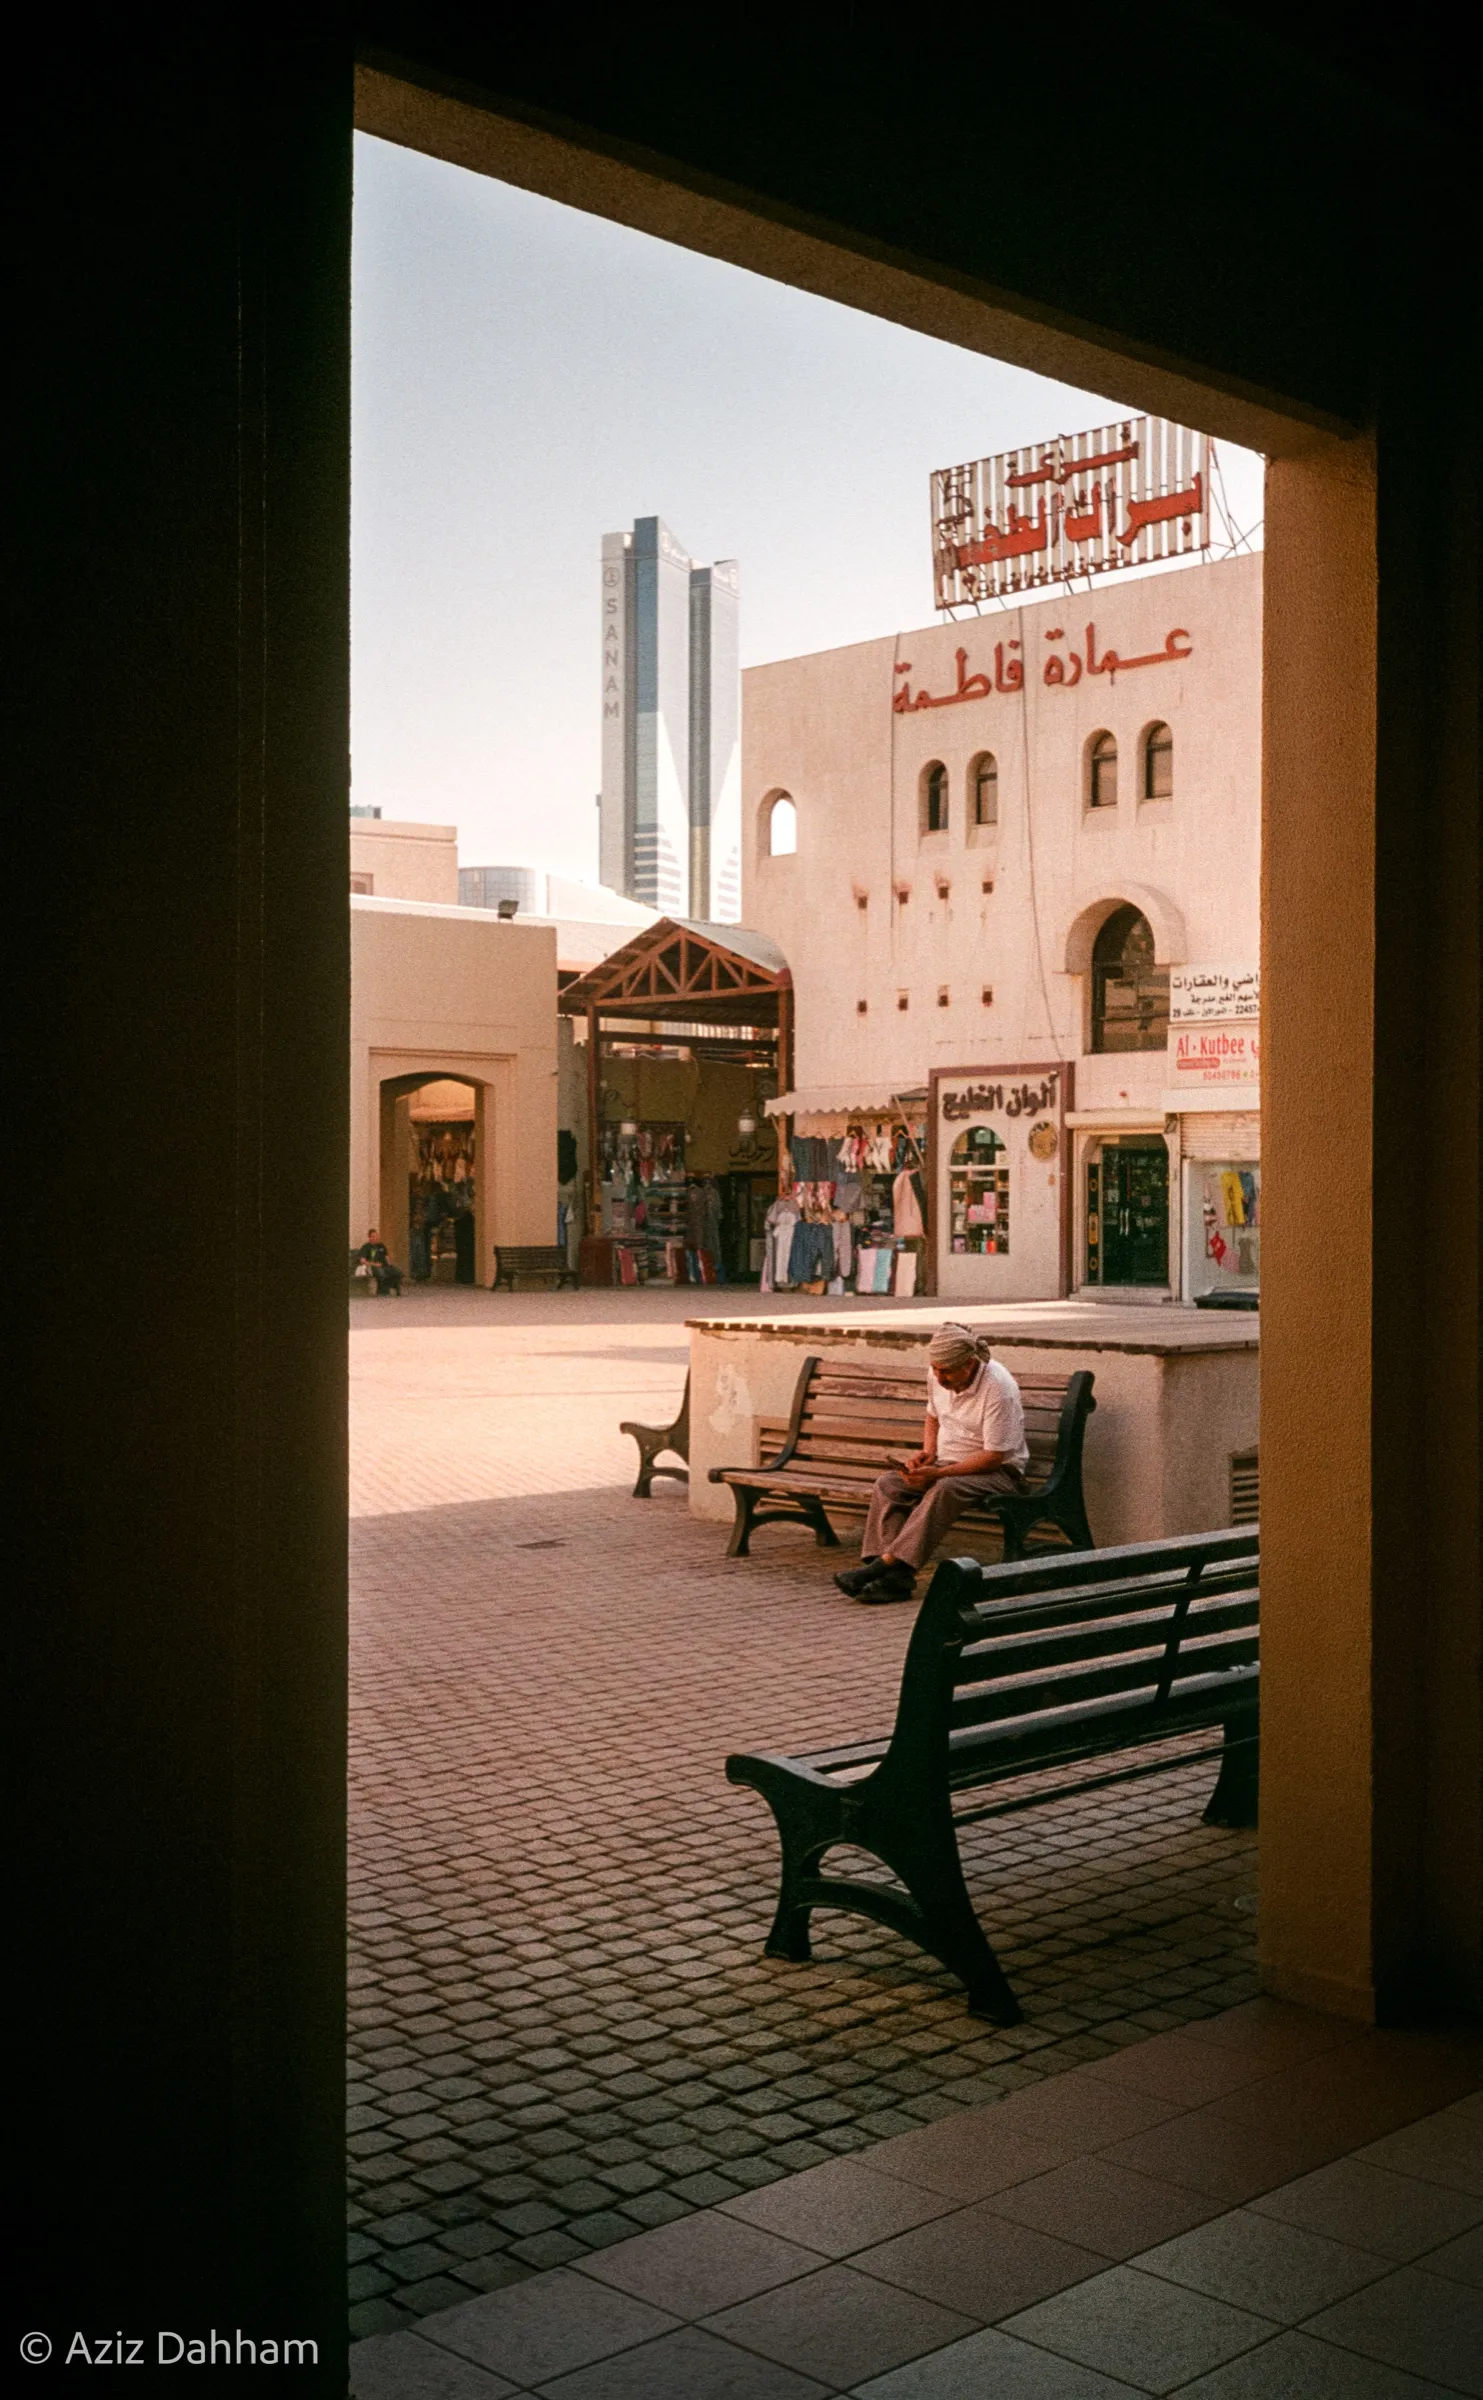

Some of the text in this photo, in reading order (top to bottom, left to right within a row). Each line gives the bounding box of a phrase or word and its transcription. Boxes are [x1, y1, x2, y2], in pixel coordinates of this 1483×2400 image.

[603, 598, 620, 719] SANAM
[892, 621, 1193, 714] عمارة فاطمة
[1172, 974, 1230, 991] والعقارات
[1176, 1035, 1189, 1057] Al
[1200, 1033, 1245, 1056] Kutbee
[942, 1083, 1003, 1121] الخليج
